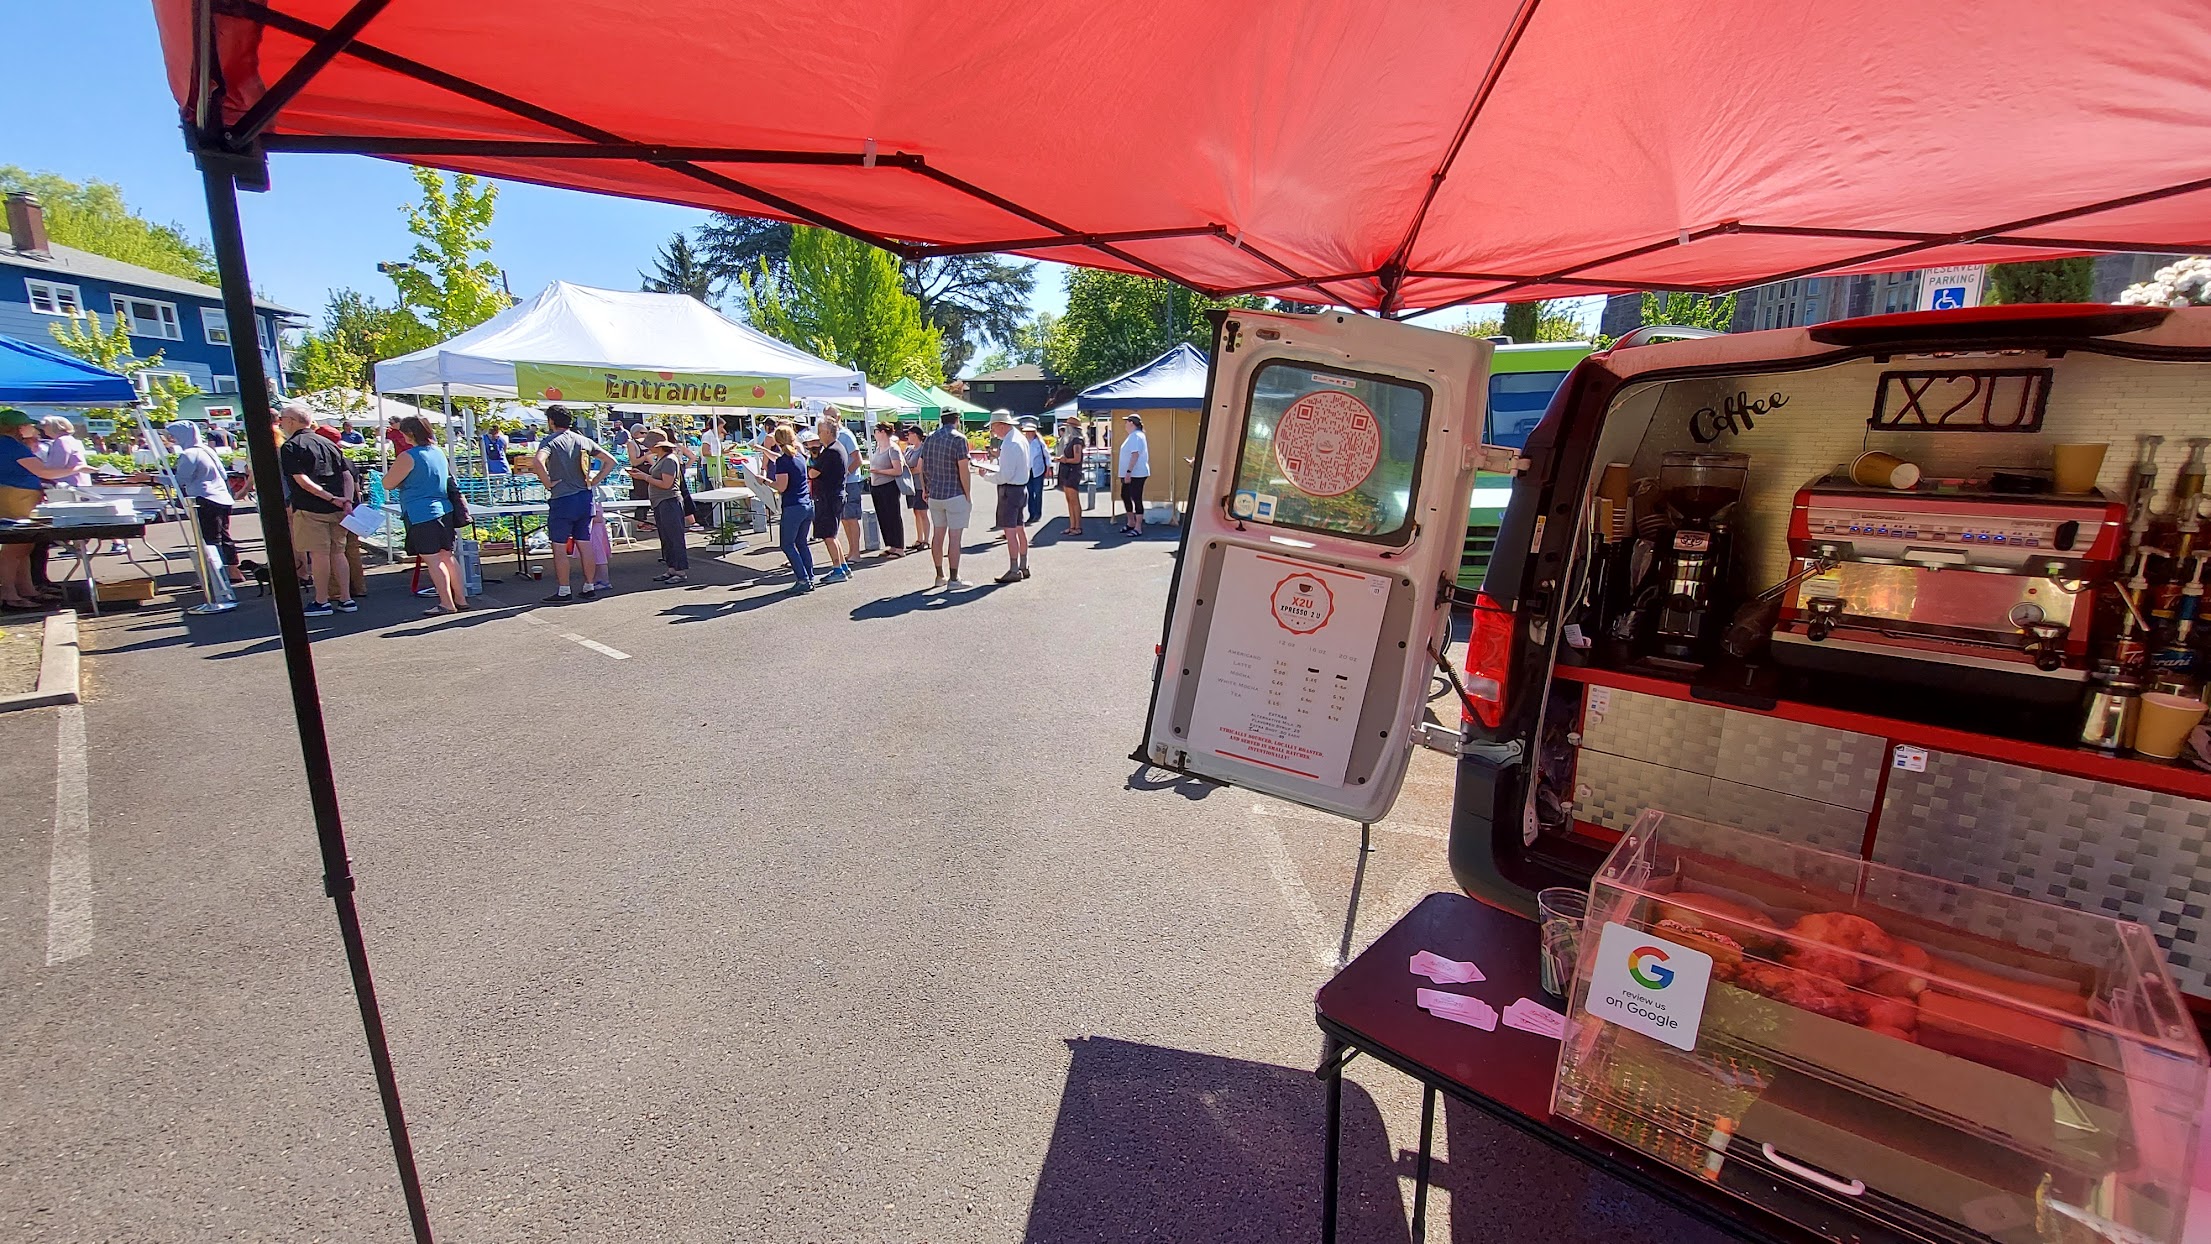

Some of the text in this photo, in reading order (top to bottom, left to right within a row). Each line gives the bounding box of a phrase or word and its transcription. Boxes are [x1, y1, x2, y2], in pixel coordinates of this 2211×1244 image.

[1926, 264, 1981, 274] RESERVED
[1929, 274, 1975, 286] PARKING
[604, 373, 728, 403] Entrance
[1890, 372, 2033, 429] X2U
[1688, 391, 1790, 444] Coffee
[1291, 596, 1314, 609] X2U
[1280, 605, 1308, 617] XPRESSO
[1227, 649, 1262, 661] AMERICANO
[1232, 660, 1252, 669] LATTE
[1229, 670, 1251, 679] MOCHA
[1217, 677, 1259, 691] WHITE MOCHA
[1268, 712, 1288, 720] EXTRAS
[1219, 726, 1325, 758] ETHICALLY SOURCED, LOCALLY ROASTED,
[1240, 738, 1261, 747] SERVED
[1267, 745, 1285, 753] SMALL
[1627, 945, 1675, 990] G
[1622, 989, 1667, 1011] review us
[1605, 996, 1679, 1029] on Google
